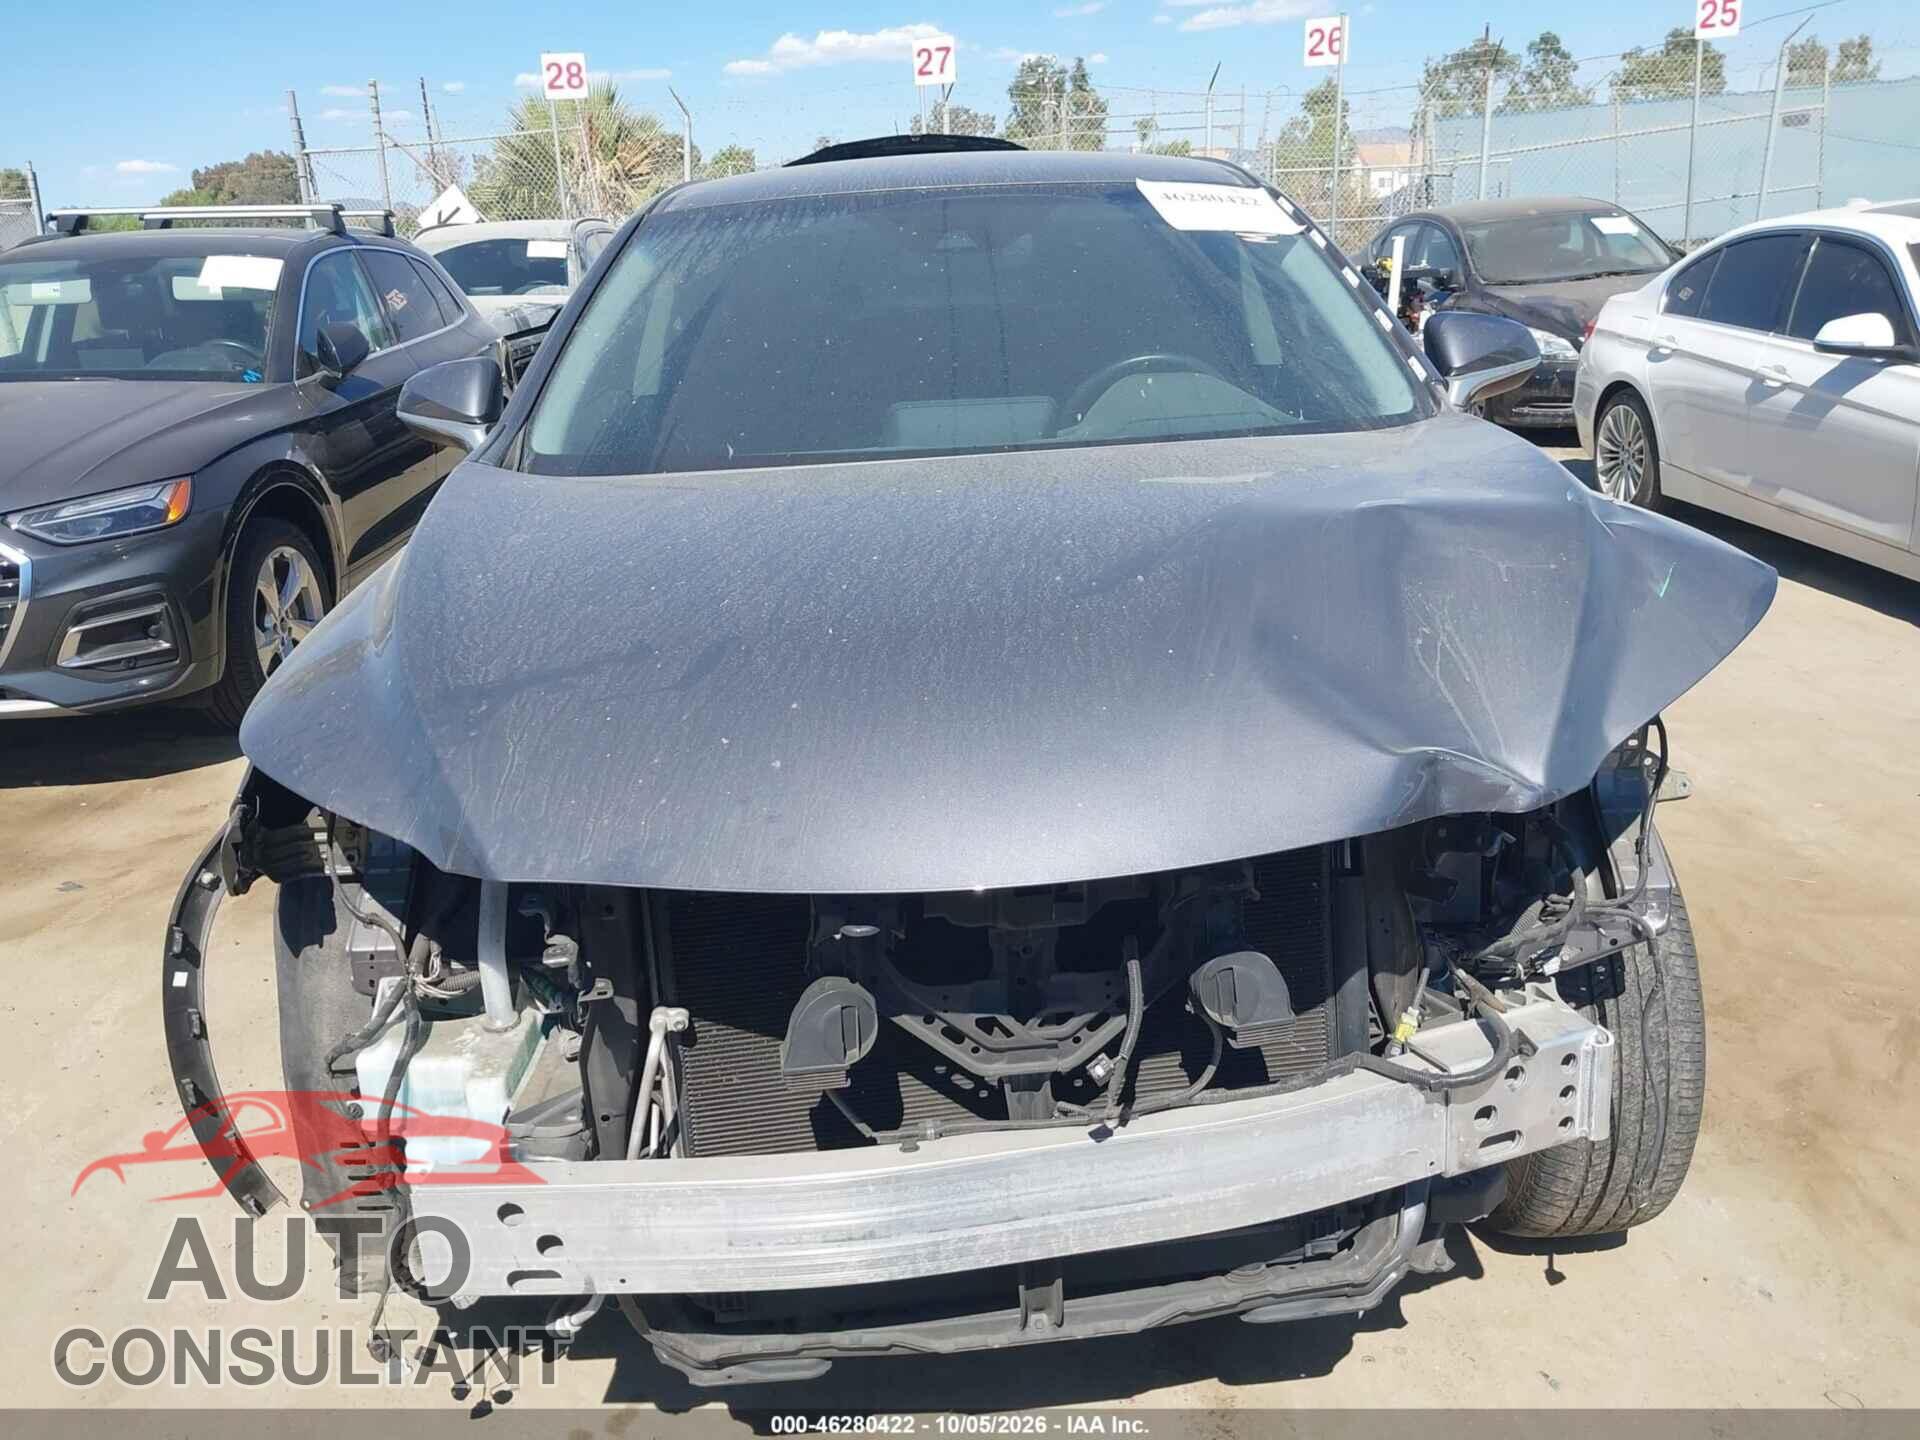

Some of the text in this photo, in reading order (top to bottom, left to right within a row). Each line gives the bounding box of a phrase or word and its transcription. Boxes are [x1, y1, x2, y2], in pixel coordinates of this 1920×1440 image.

[1699, 0, 1737, 29] 25
[1308, 26, 1342, 57] 26
[545, 61, 584, 90] 28
[916, 46, 951, 76] 27
